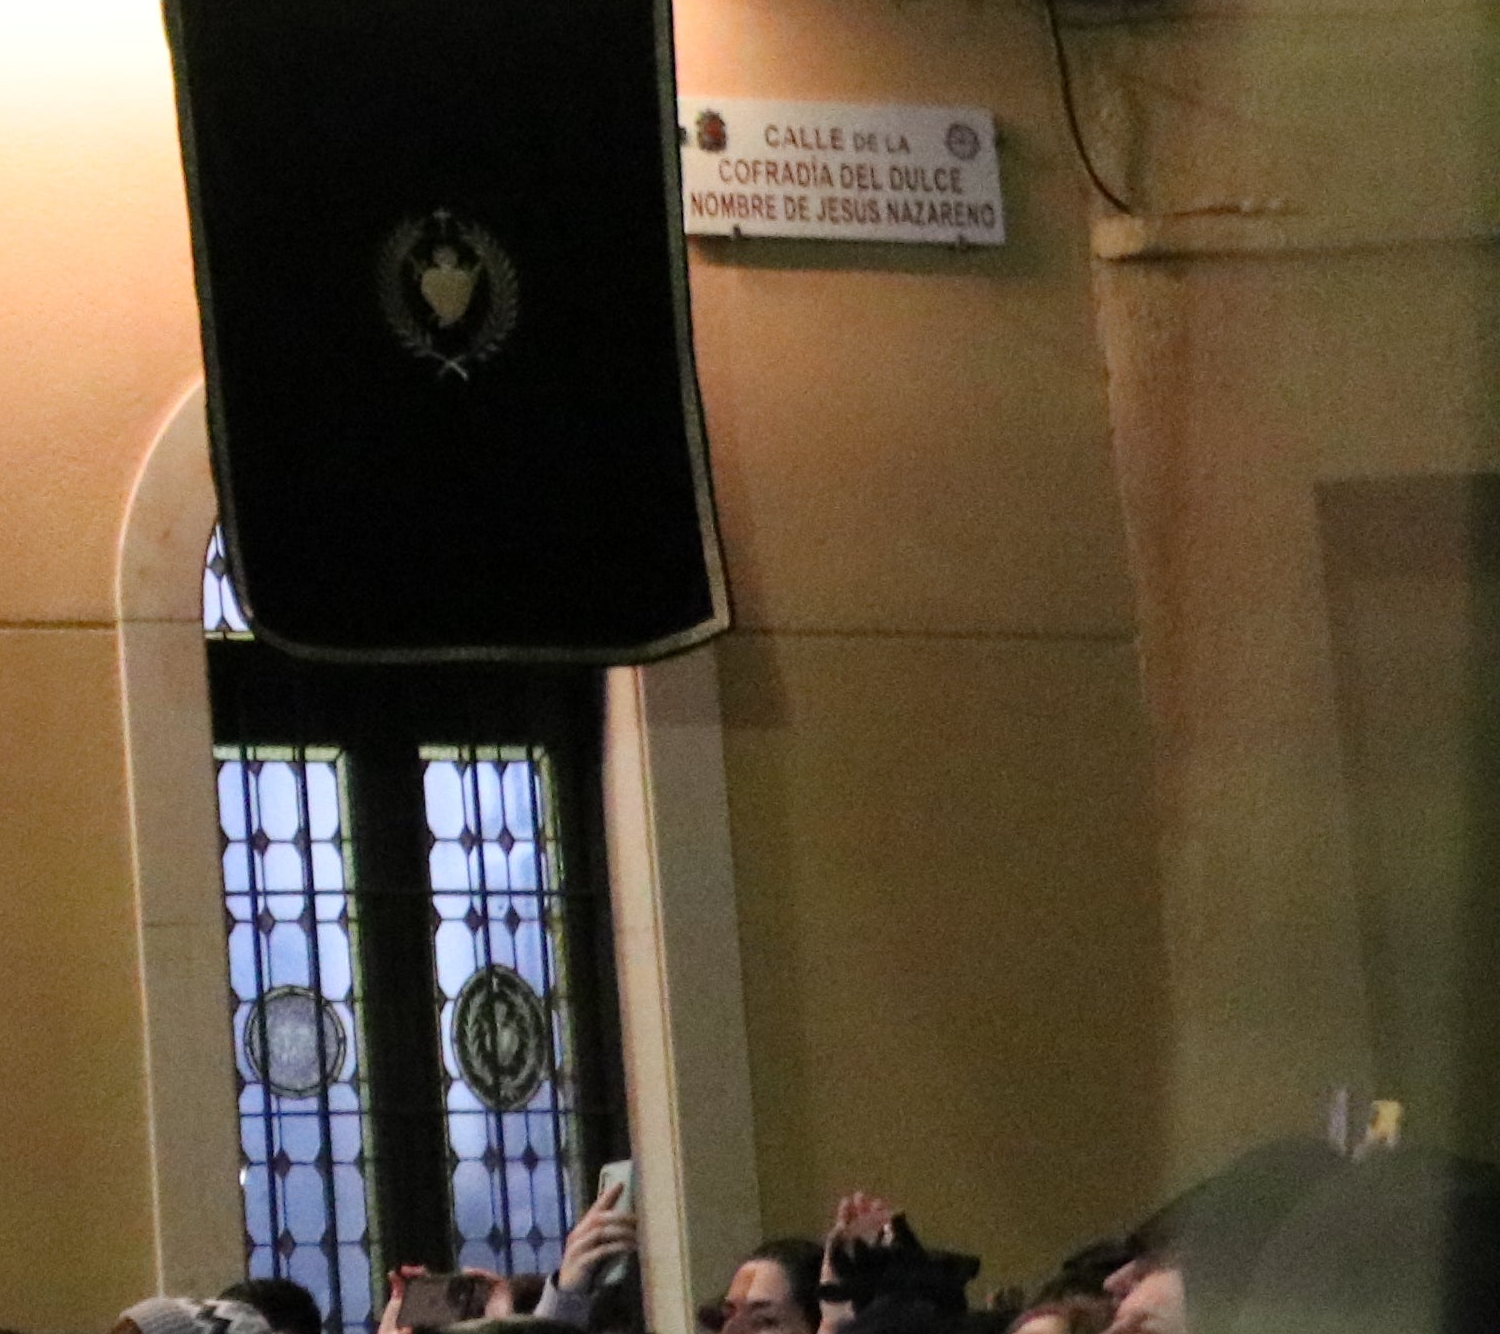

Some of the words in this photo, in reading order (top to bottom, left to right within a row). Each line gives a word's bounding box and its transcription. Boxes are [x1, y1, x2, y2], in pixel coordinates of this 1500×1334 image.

[764, 123, 845, 151] CALLE
[853, 130, 878, 153] DE
[886, 133, 911, 155] LA
[718, 155, 834, 188] COFRADÍA
[839, 162, 883, 191] DEL
[889, 165, 964, 194] DULCE
[690, 191, 777, 220] NOMBRE
[783, 194, 811, 221] DE
[815, 196, 881, 225] JESUS
[886, 200, 996, 230] NAZARENO
